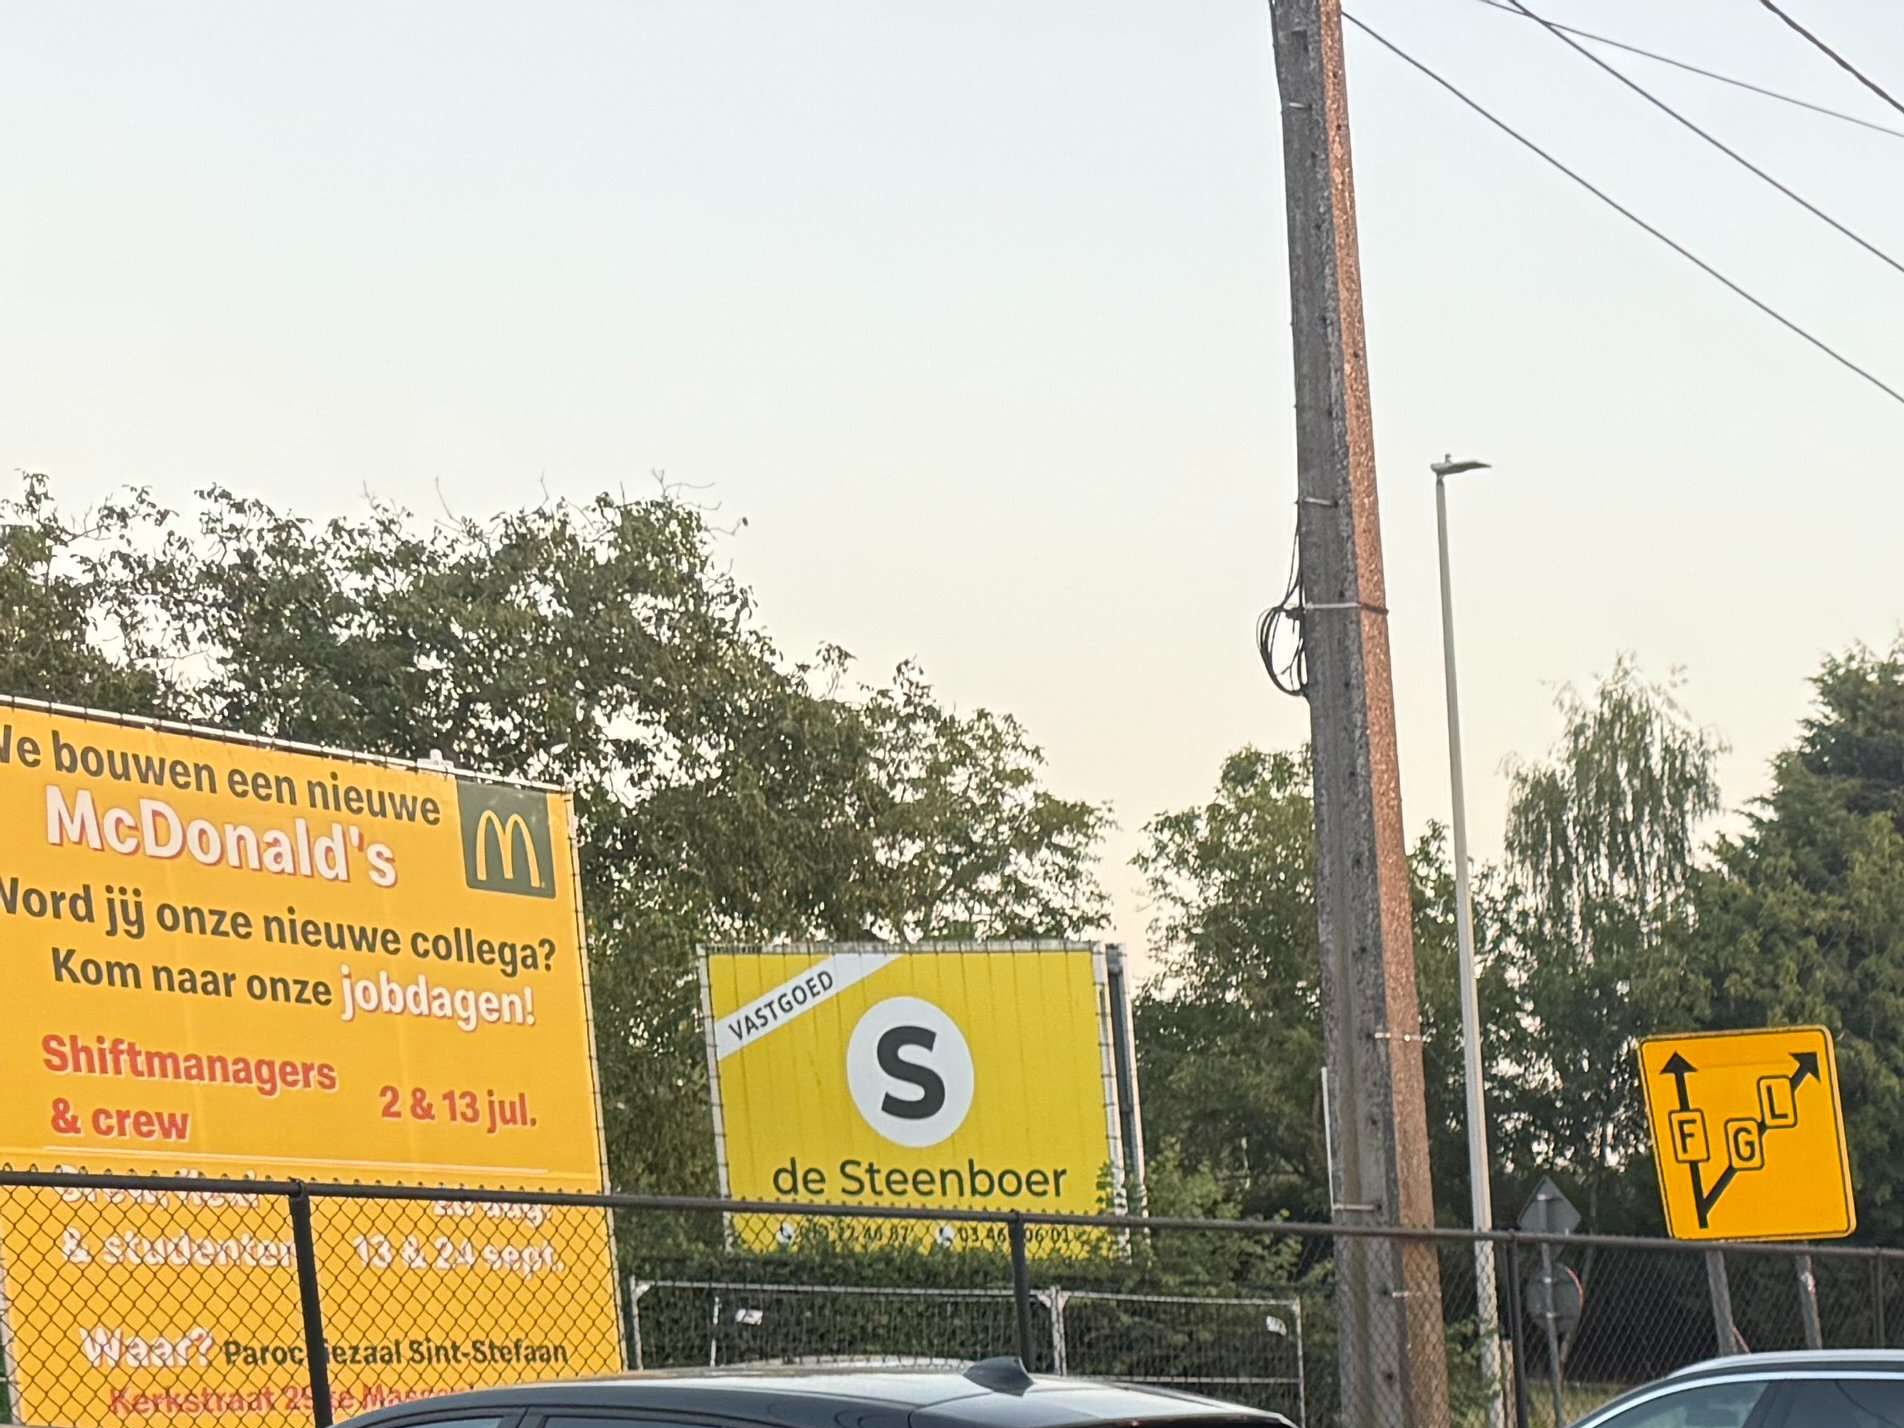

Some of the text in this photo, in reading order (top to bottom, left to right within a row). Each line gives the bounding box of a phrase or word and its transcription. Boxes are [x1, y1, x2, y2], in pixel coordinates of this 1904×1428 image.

[51, 730, 217, 794] bouwen
[227, 768, 297, 805] een
[307, 771, 441, 825] nieuwe
[45, 784, 398, 888] McDonald's
[104, 884, 145, 939] jij
[156, 902, 252, 939] onze
[263, 905, 401, 954] nieuwe
[410, 927, 556, 977] collega?
[51, 947, 535, 1032] Kom naar onze jobdagen!
[728, 970, 834, 1041] VASTGOED
[41, 1034, 338, 1097] Shiftmanagers
[877, 1026, 945, 1119] S
[51, 1097, 189, 1140] & crew
[379, 1085, 537, 1133] 2 & 13 jul.
[1766, 1085, 1788, 1120] L
[1678, 1119, 1697, 1154] F
[1733, 1127, 1755, 1162] G
[773, 1157, 1067, 1197] de Steenboer
[63, 1225, 92, 1264] &
[352, 1234, 392, 1269] 13
[400, 1234, 428, 1269] &
[79, 1326, 214, 1368] Waar?
[224, 1340, 568, 1365] Parociezaal Sint-Stefaan
